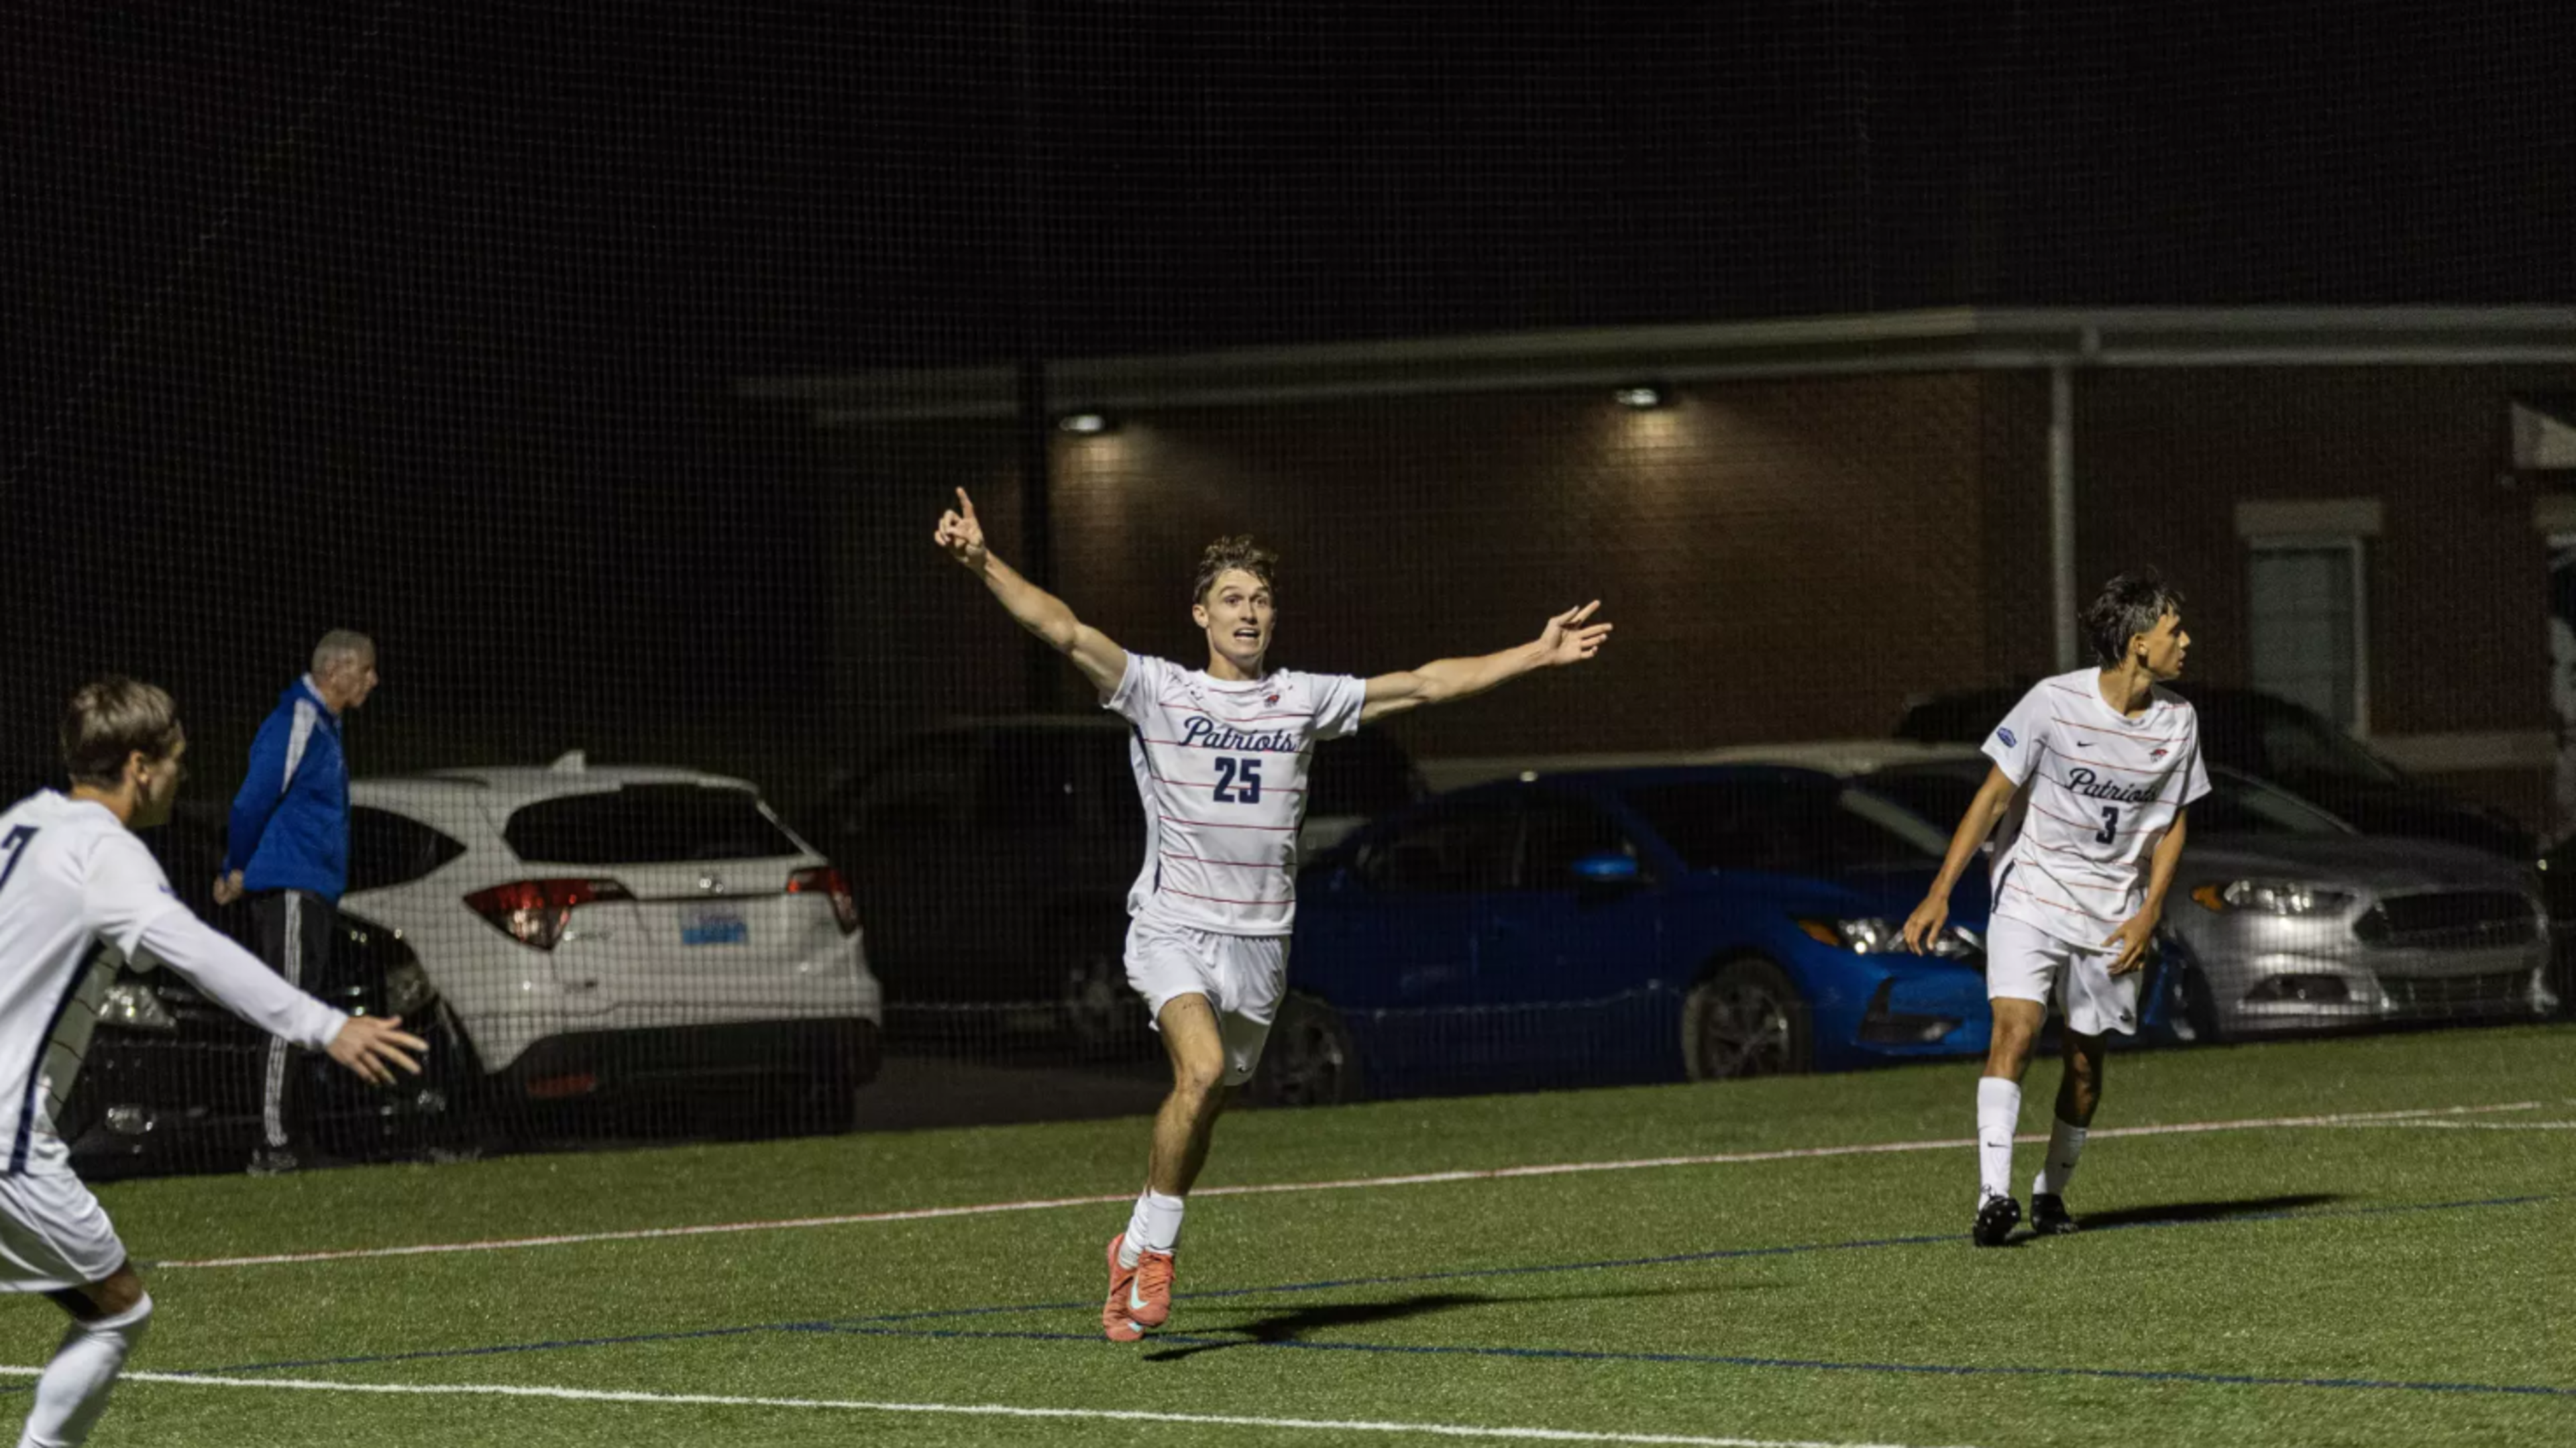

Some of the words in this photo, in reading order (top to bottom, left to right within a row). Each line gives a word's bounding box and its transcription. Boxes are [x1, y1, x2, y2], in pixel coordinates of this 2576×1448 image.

[1178, 716, 1296, 752] Patriots
[1213, 757, 1261, 803] 25
[2096, 806, 2119, 844] 3
